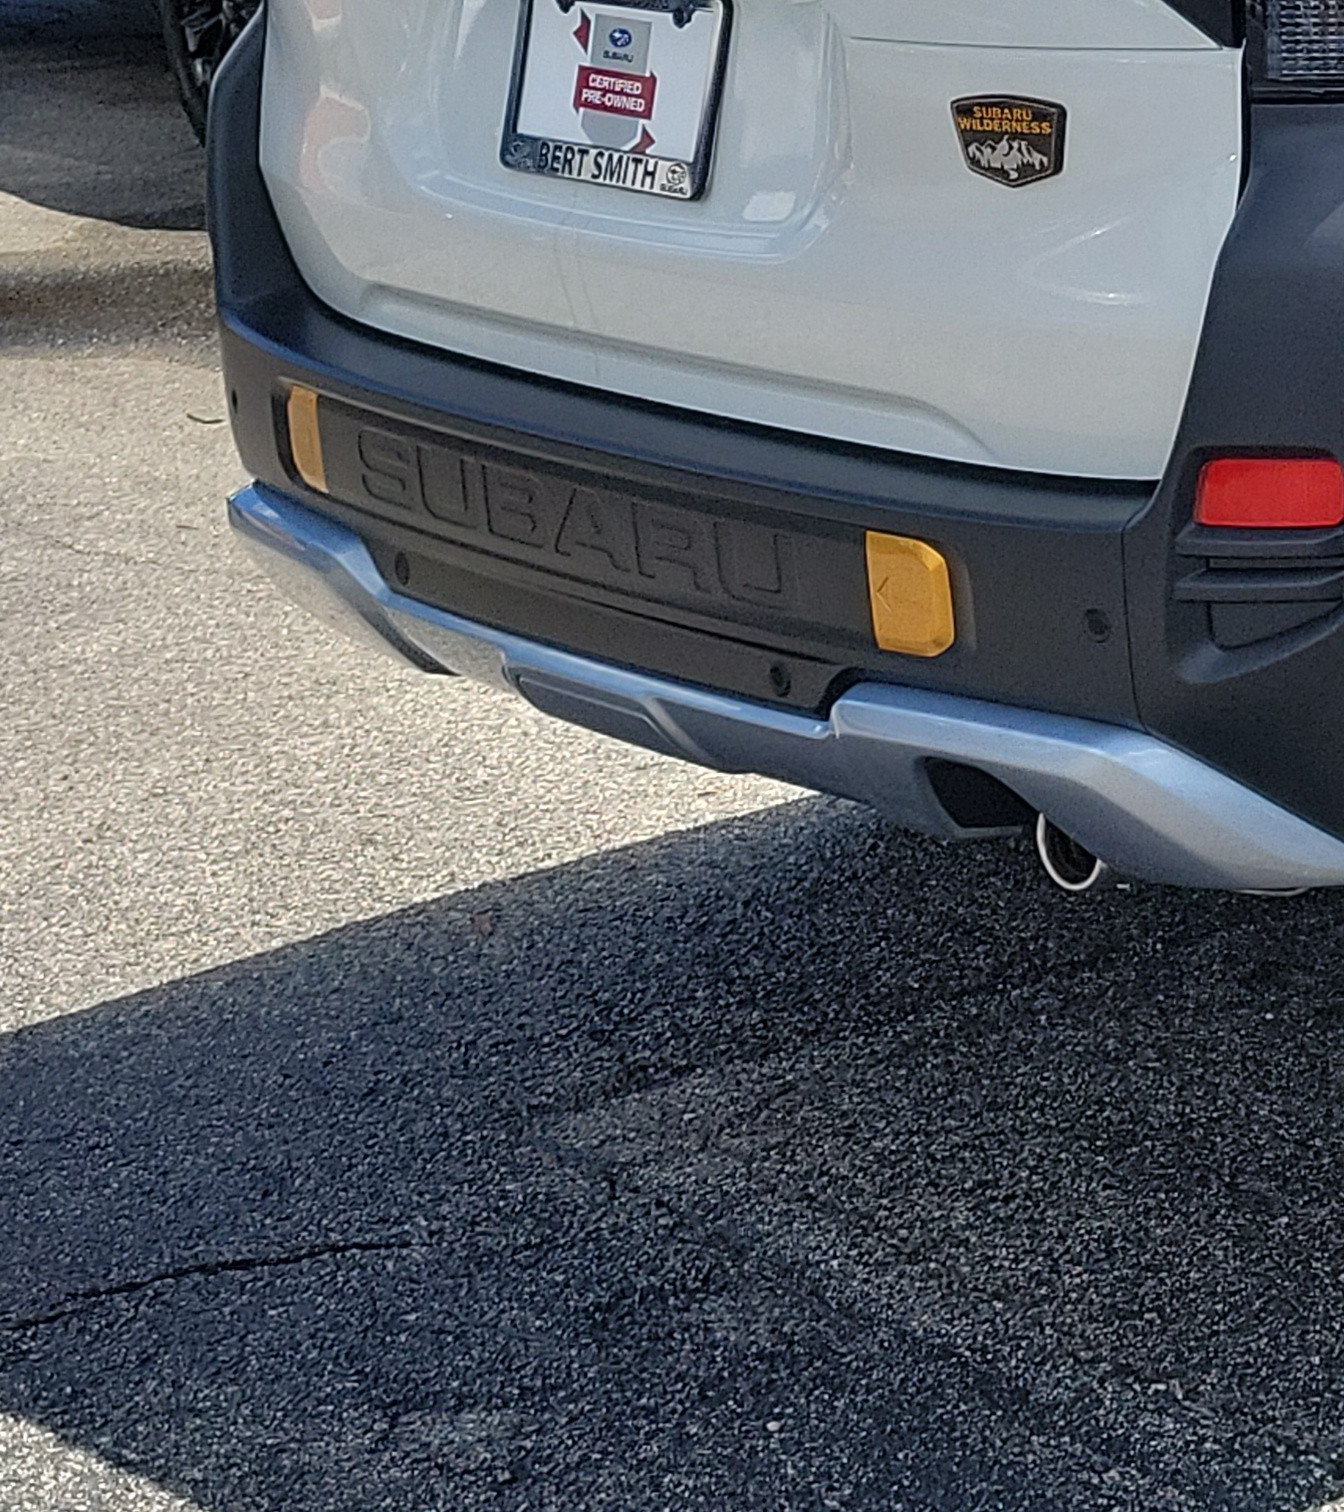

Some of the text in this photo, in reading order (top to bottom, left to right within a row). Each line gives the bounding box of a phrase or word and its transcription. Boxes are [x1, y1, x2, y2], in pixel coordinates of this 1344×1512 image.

[588, 73, 643, 95] CERTIFIED
[581, 88, 645, 112] PRE-OWNED
[957, 115, 1052, 134] WILDERNESS
[973, 106, 1033, 121] SUBARU
[538, 141, 658, 190] BERT SMITH
[355, 424, 792, 610] SUBARU
